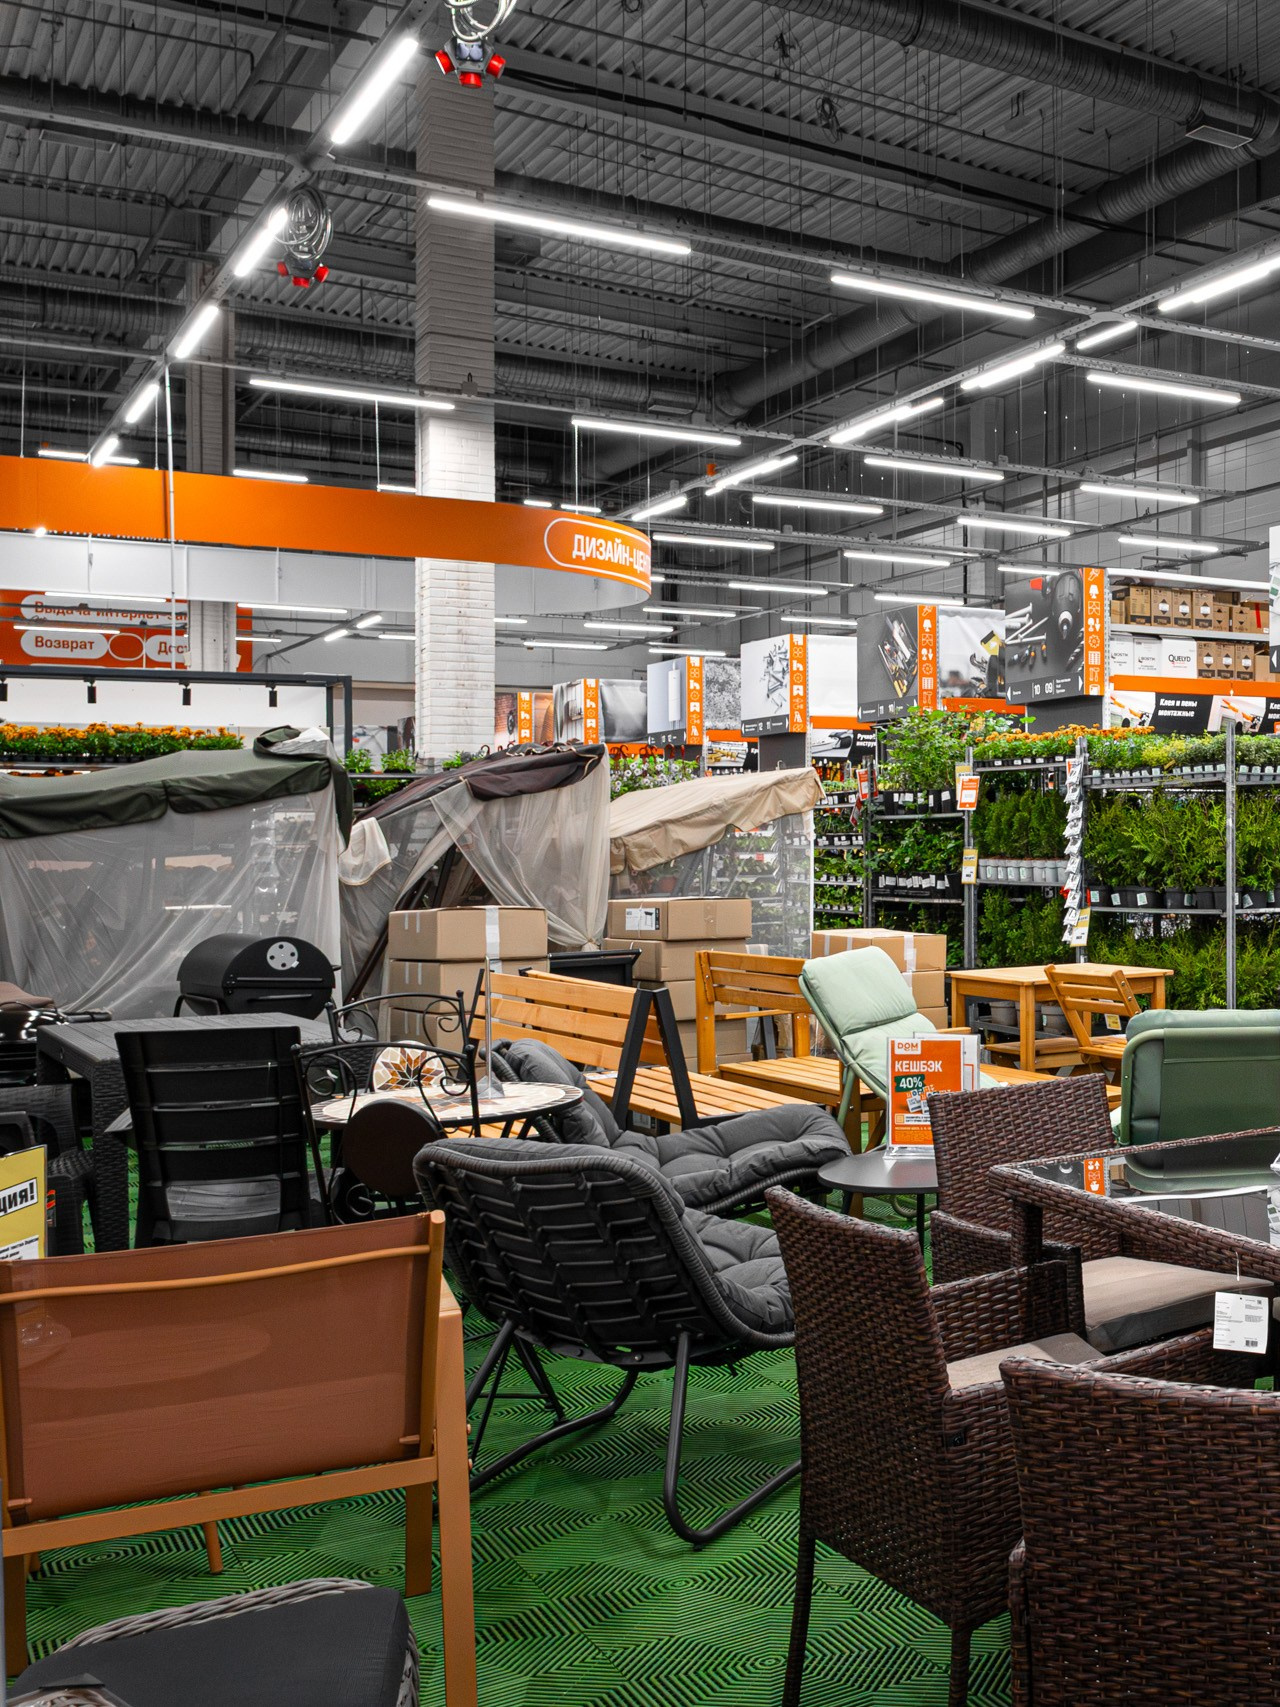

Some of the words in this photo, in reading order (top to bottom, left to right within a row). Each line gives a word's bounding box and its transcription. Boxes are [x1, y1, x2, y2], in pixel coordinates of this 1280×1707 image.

[34, 635, 95, 652] Возврат
[1168, 654, 1191, 663] QUELYD
[897, 1042, 918, 1050] DOM
[895, 1060, 942, 1073] КЕШБЭК
[900, 1077, 922, 1088] 40%
[0, 1182, 34, 1213] ция!
